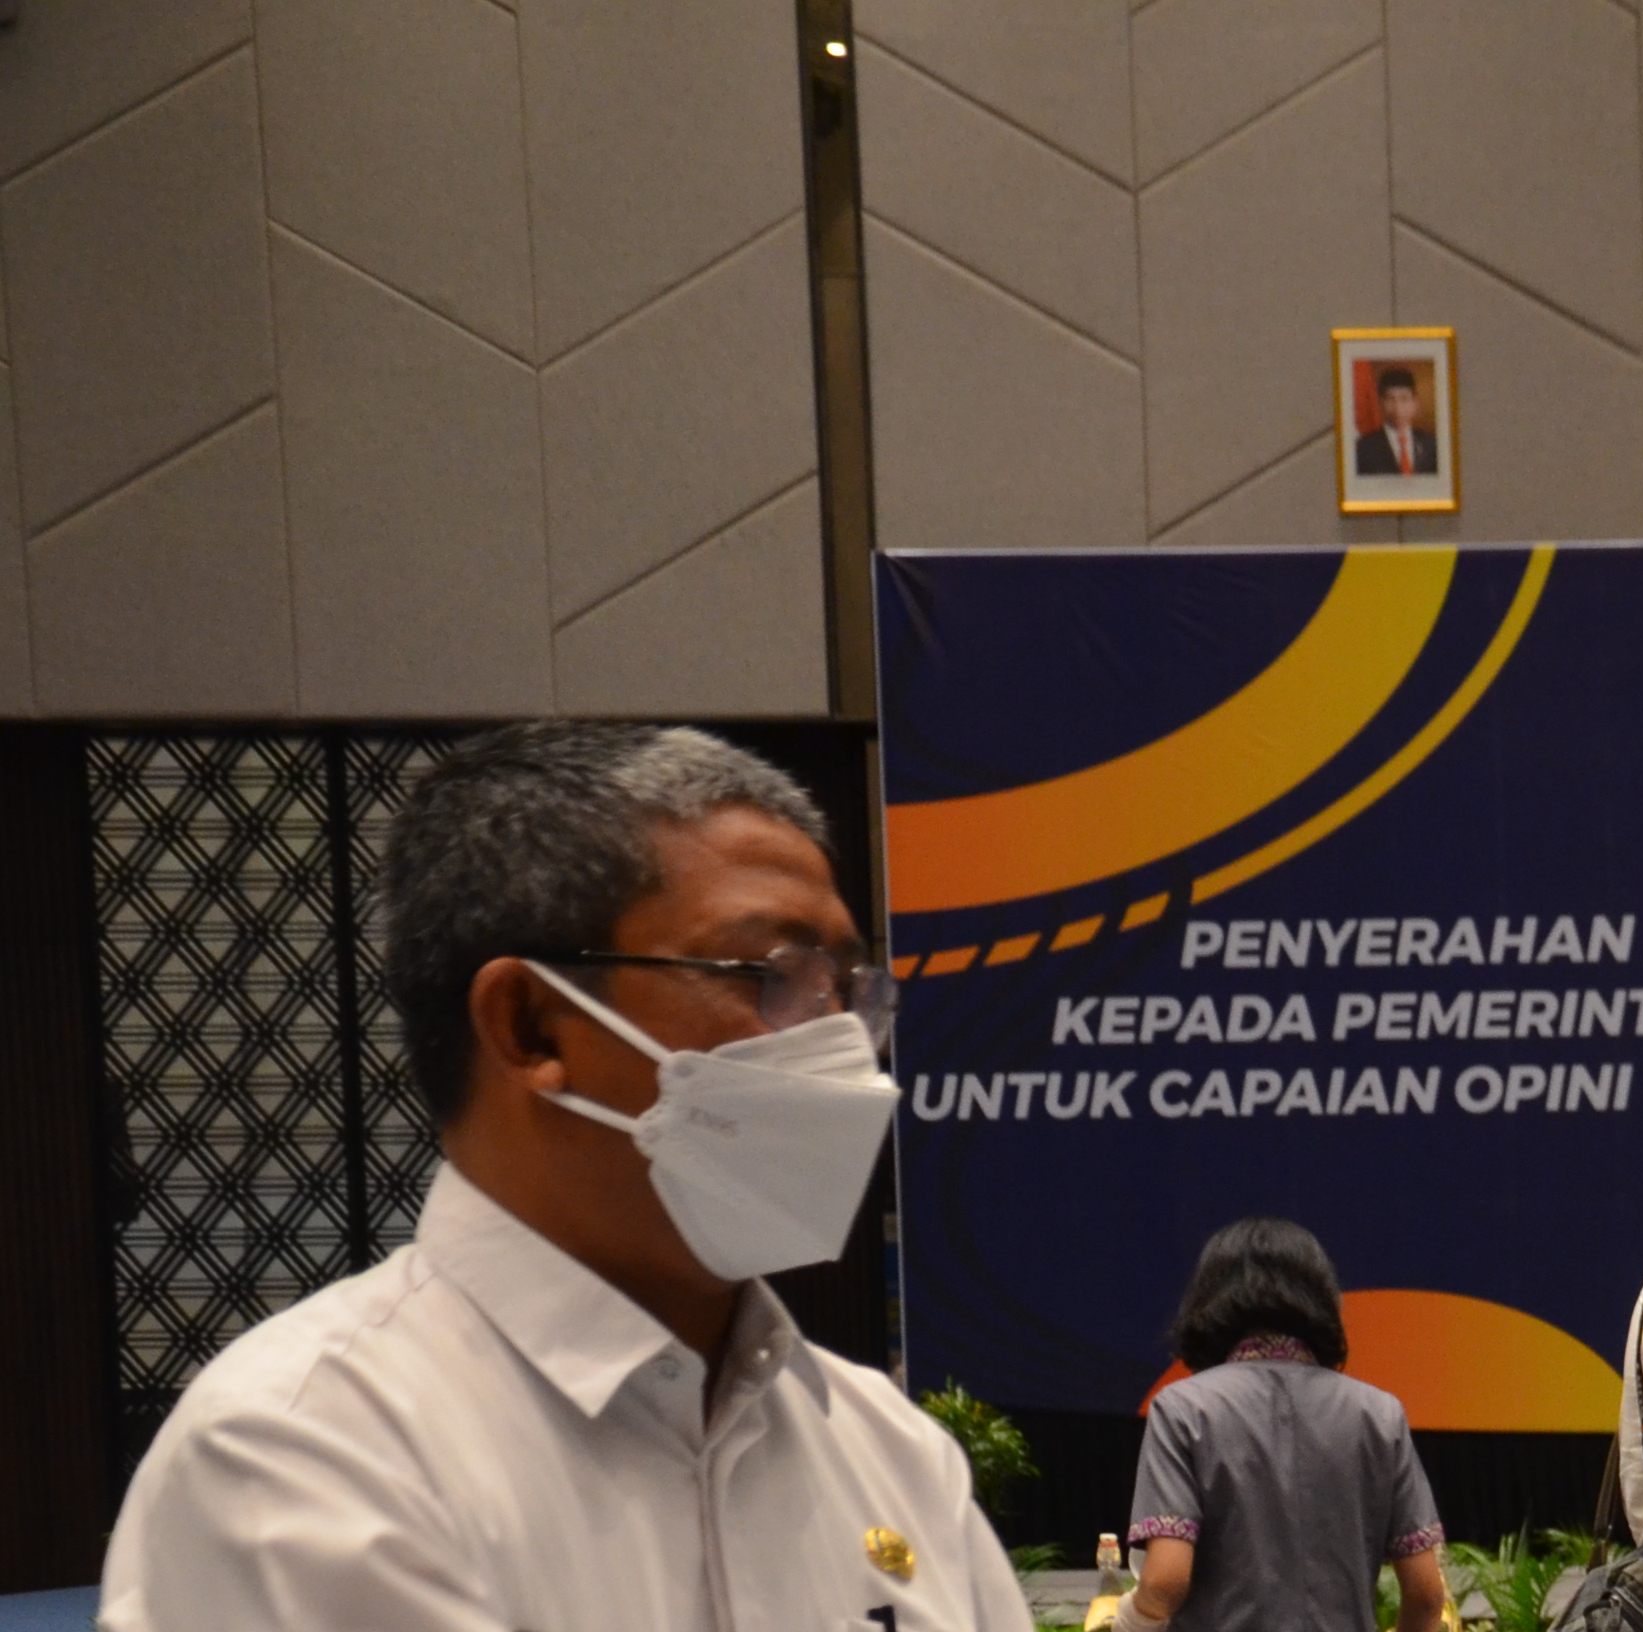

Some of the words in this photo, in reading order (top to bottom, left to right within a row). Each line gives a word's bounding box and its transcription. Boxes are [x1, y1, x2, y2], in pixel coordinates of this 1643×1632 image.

[1180, 914, 1636, 969] PENYERAHAN
[1051, 994, 1316, 1044] KEPADA
[911, 1071, 1137, 1121] UNTUK
[1149, 1066, 1441, 1118] CAPAIAN
[1454, 1063, 1634, 1113] OPINI
